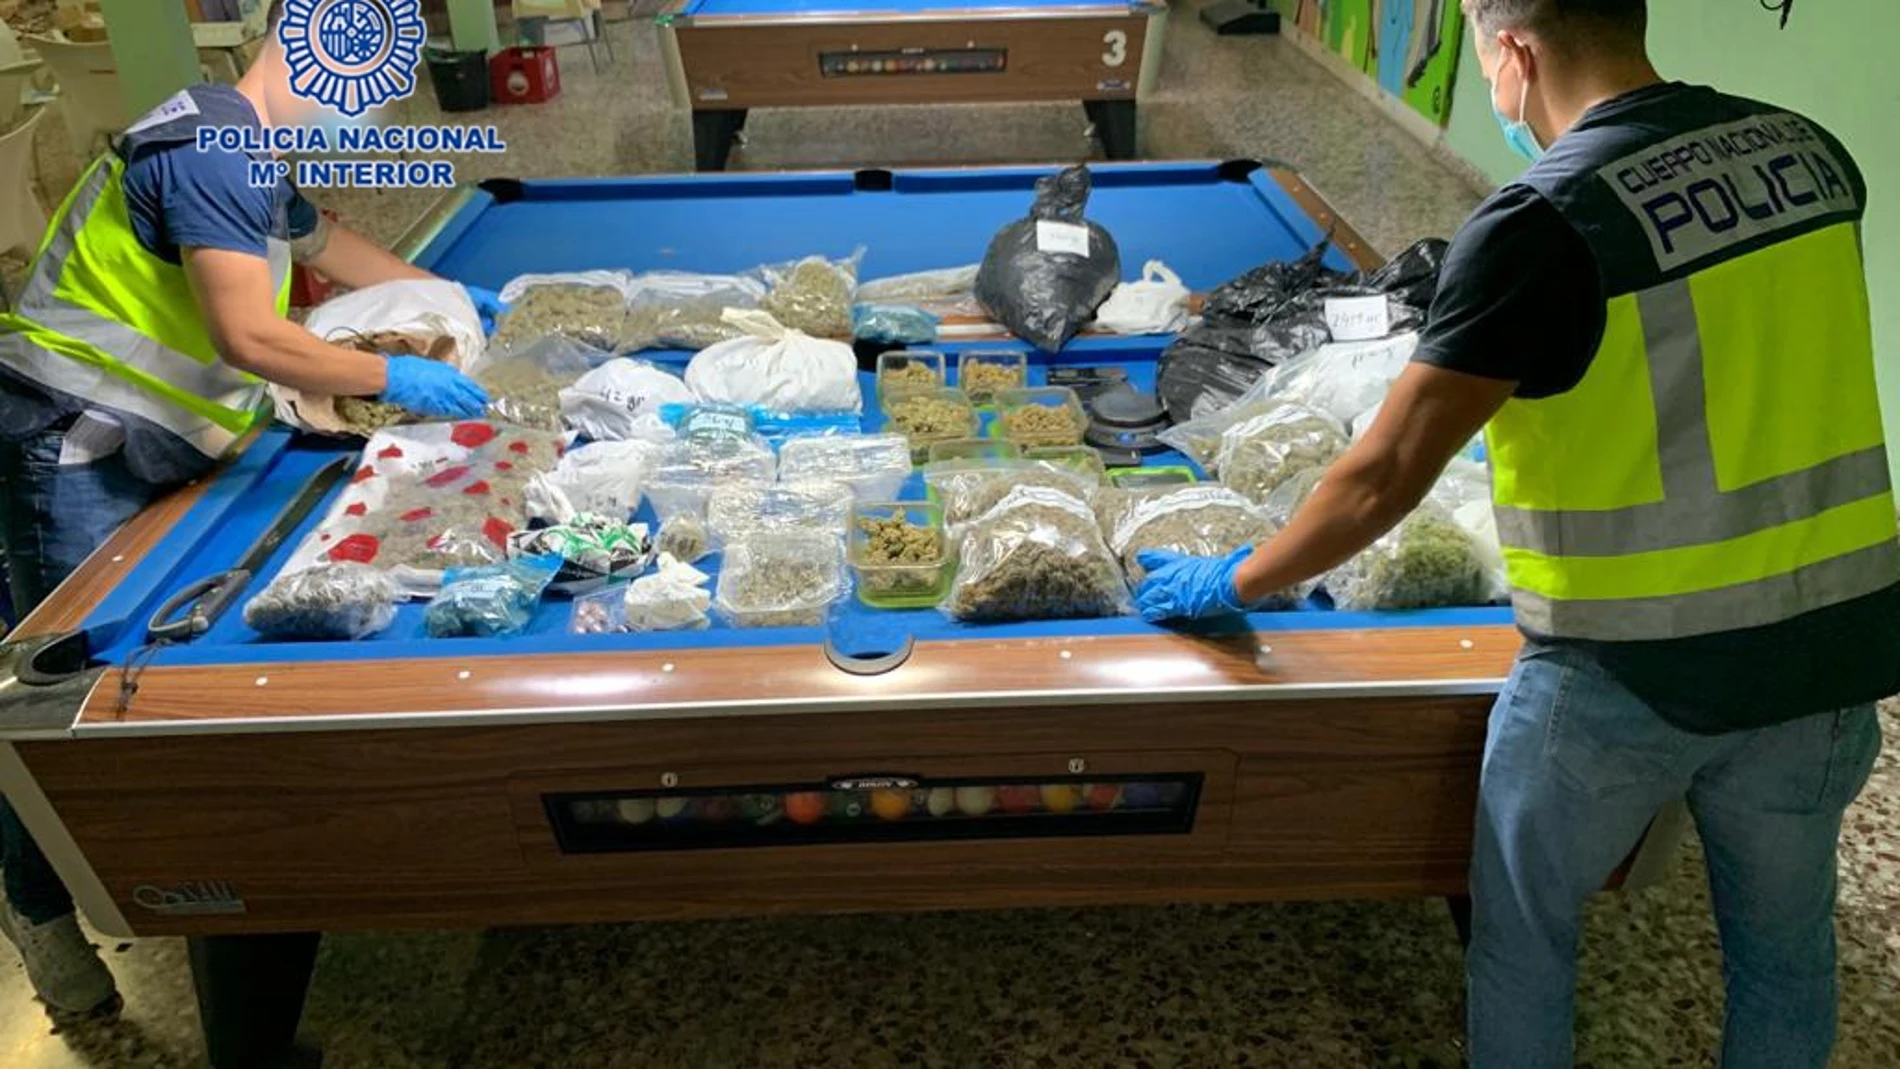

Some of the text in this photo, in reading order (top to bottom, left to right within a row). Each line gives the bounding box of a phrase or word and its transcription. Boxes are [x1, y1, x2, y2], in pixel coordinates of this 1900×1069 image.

[1102, 30, 1127, 66] 3
[1616, 142, 1712, 194] CUERPO
[1641, 153, 1849, 254] POLICIA
